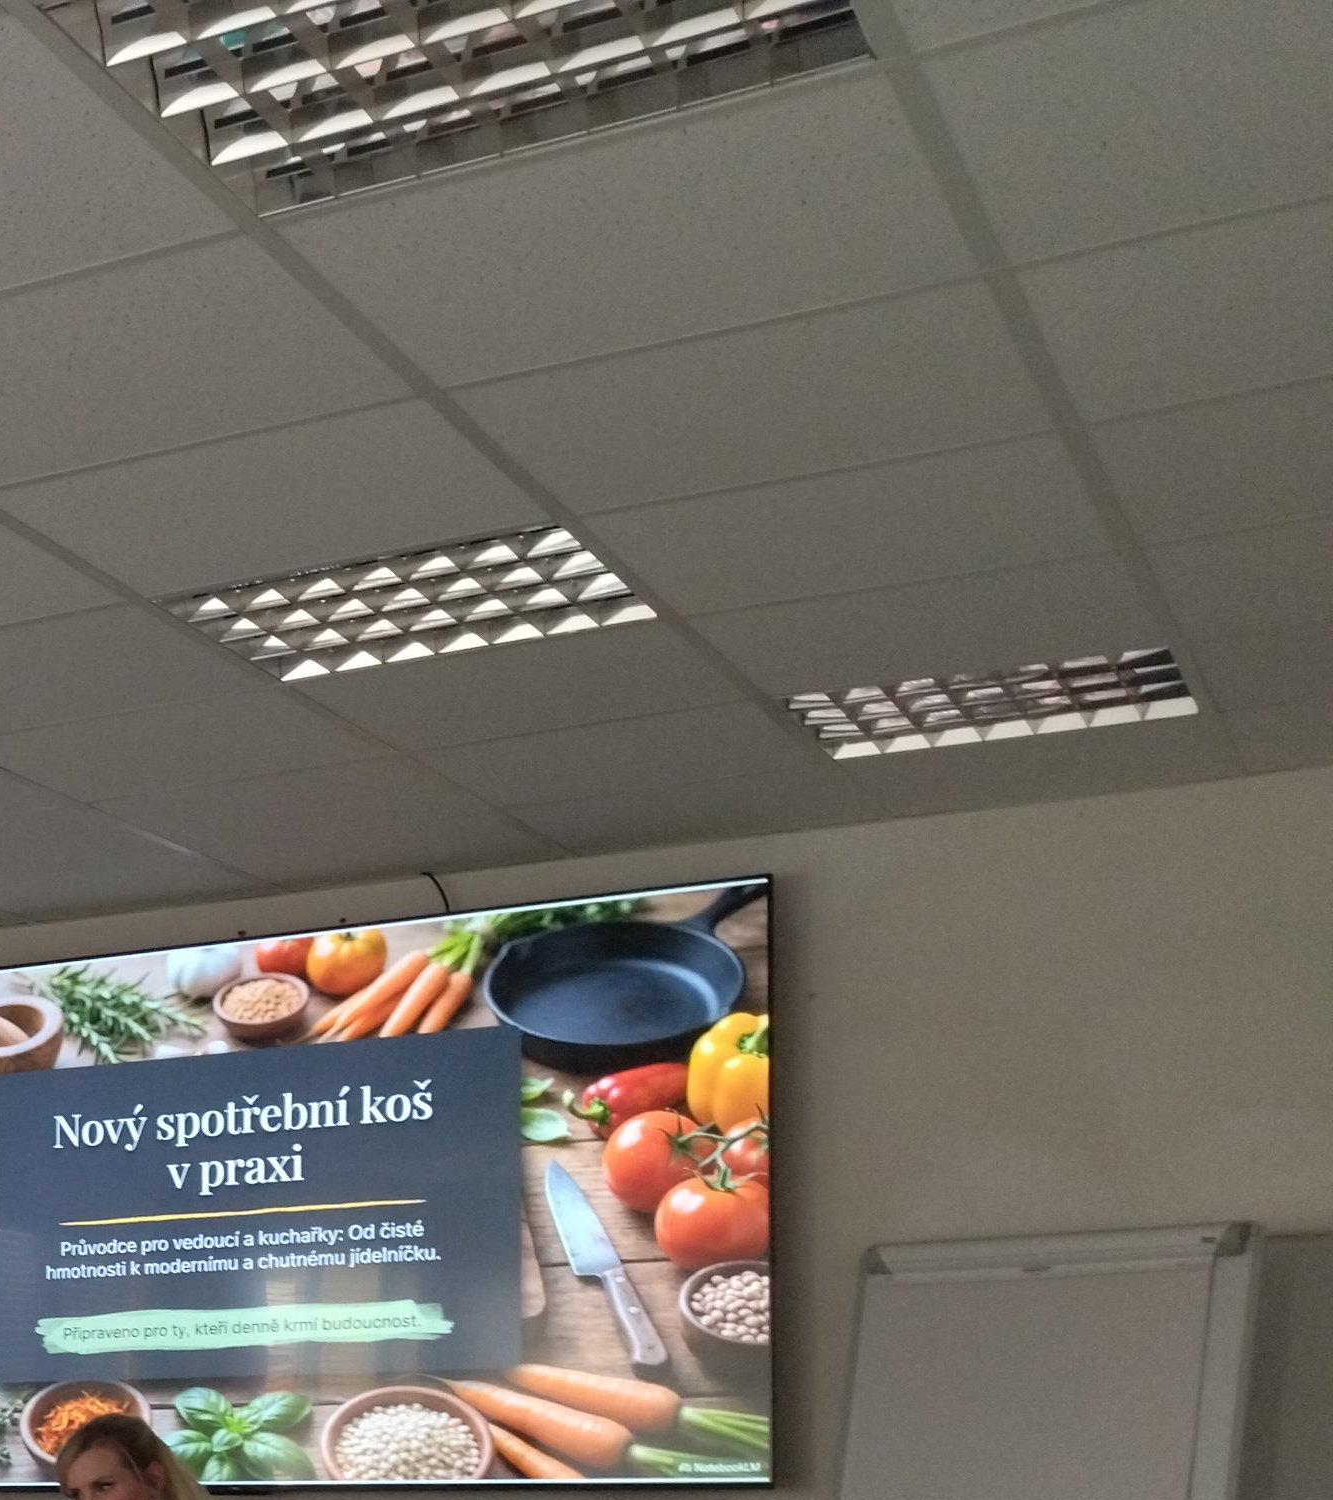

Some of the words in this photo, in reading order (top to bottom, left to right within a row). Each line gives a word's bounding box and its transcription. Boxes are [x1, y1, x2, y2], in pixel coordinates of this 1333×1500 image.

[52, 1103, 148, 1152] Nový
[156, 1084, 351, 1148] spotřební
[359, 1078, 434, 1125] koš
[167, 1162, 192, 1190] v
[198, 1143, 306, 1196] praxi
[60, 1236, 137, 1257] Průvodce
[141, 1238, 169, 1256] pro
[173, 1230, 241, 1252] vedoucí
[243, 1234, 255, 1247] a
[258, 1224, 344, 1248] kuchařky:
[348, 1224, 375, 1242] Od
[380, 1219, 425, 1240] čisté
[45, 1261, 127, 1281] hmotnosti
[130, 1260, 141, 1276] k
[144, 1253, 240, 1275] modernímu
[243, 1258, 254, 1270] a
[258, 1249, 346, 1271] chutnému
[348, 1243, 442, 1269] jídelníčku.
[63, 1325, 140, 1343] Připraveno
[144, 1327, 169, 1341] pro
[172, 1322, 191, 1339] ty,
[194, 1319, 228, 1336] kteří
[232, 1317, 280, 1334] denně
[283, 1316, 318, 1332] krmí
[321, 1312, 422, 1331] budoucnost.
[693, 1461, 762, 1473] NotebookLM
